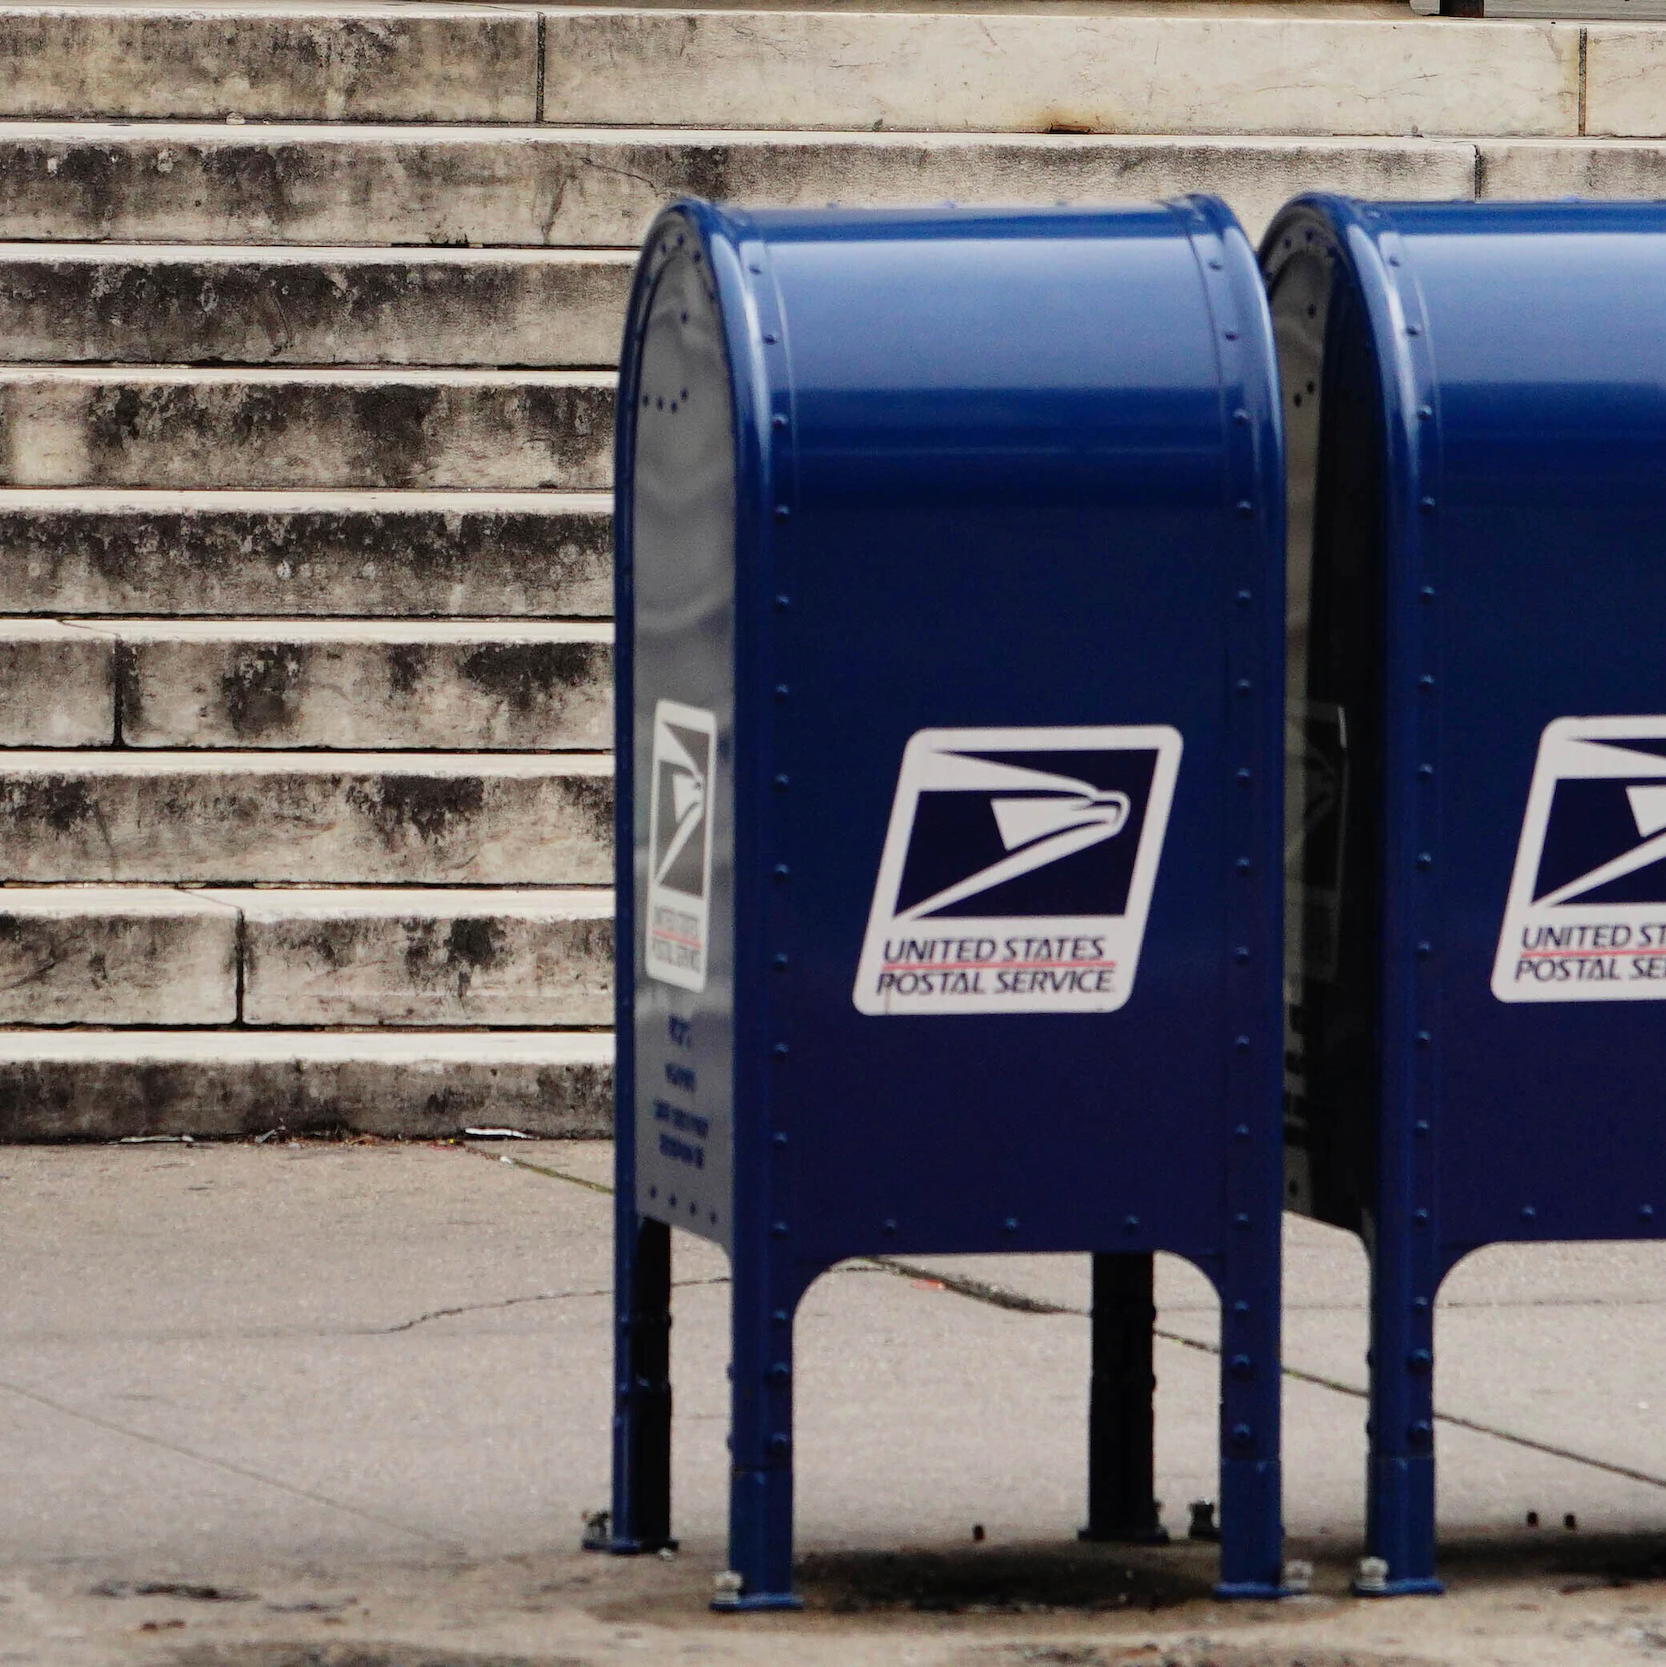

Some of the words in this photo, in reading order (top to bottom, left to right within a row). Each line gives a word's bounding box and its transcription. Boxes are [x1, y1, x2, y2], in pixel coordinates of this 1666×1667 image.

[884, 938, 997, 963] UNITED
[1004, 936, 1106, 961] STATES
[1521, 924, 1632, 950] UNITED
[876, 971, 986, 996] POSTAL
[994, 969, 1115, 994] SERVICE
[1515, 957, 1621, 982] POSTAL
